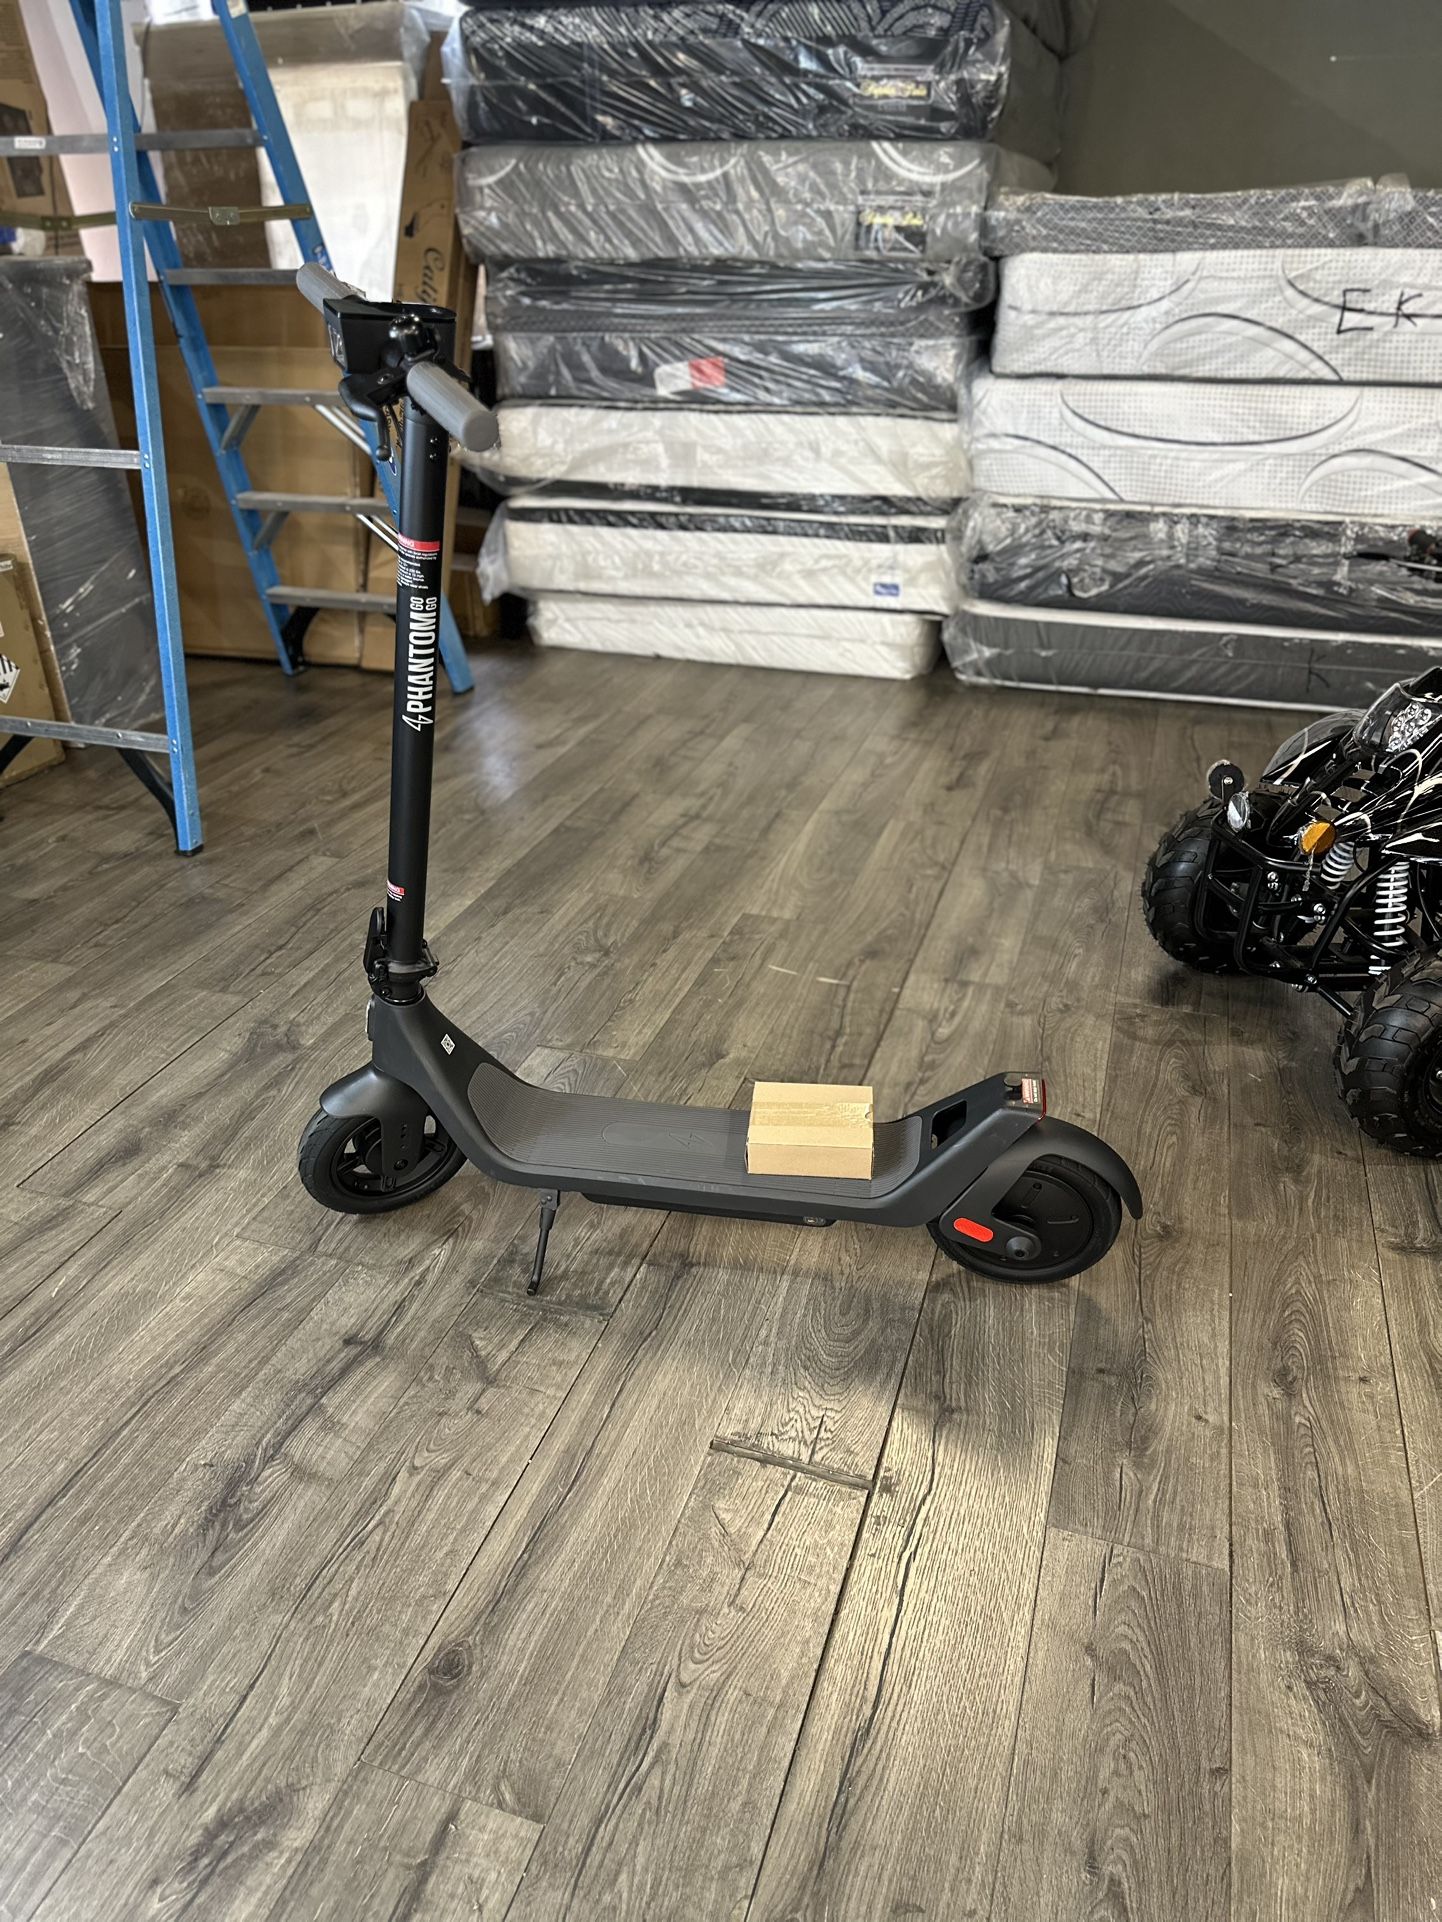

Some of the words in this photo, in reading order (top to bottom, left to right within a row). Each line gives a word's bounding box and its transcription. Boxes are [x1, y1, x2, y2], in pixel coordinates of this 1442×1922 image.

[409, 596, 424, 611] GO
[425, 596, 438, 611] GO
[406, 611, 437, 713] PHANTOM
